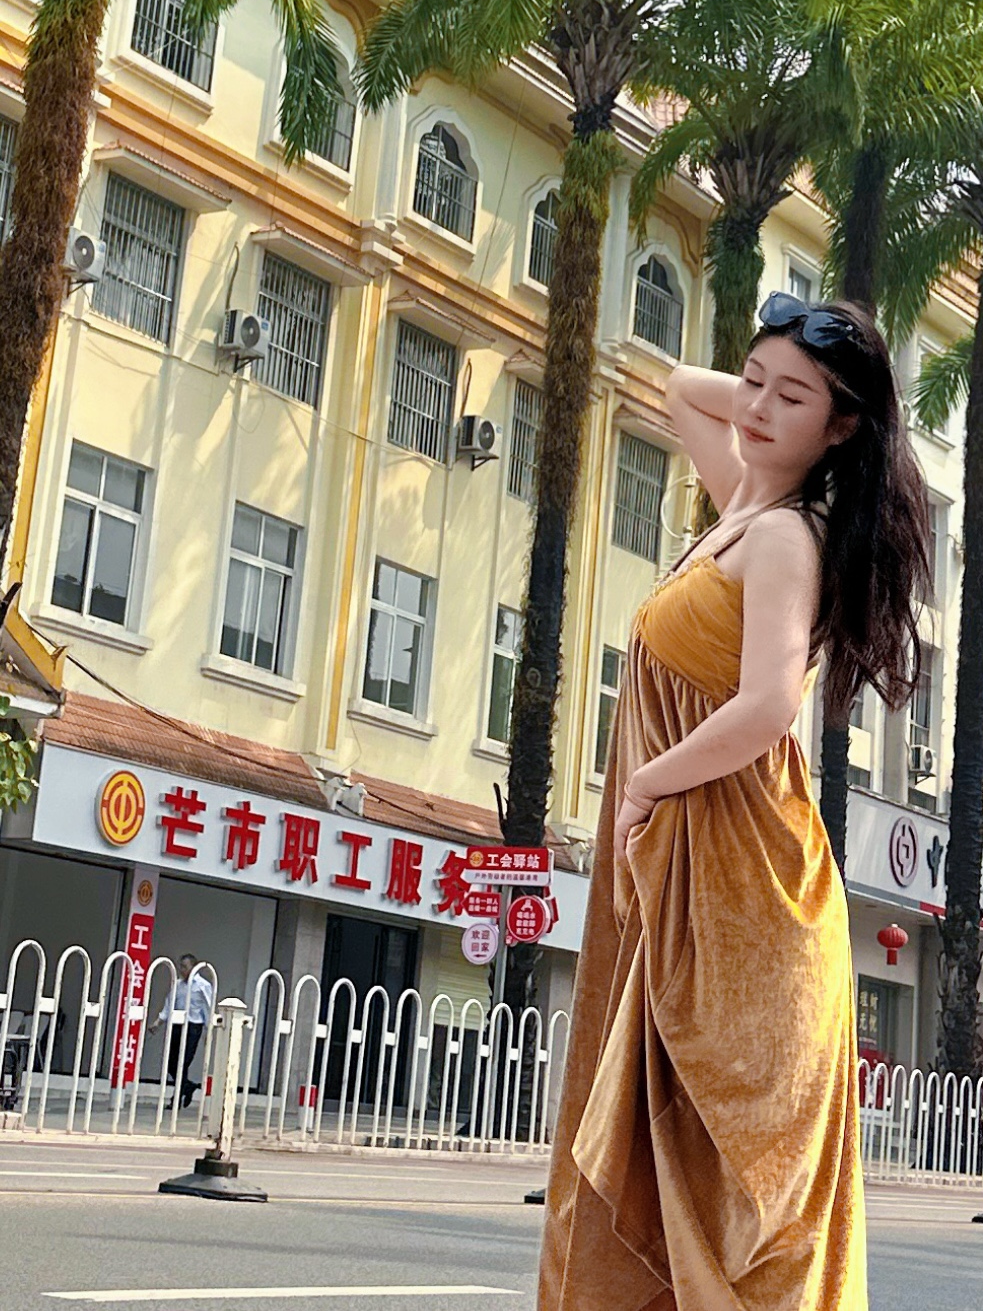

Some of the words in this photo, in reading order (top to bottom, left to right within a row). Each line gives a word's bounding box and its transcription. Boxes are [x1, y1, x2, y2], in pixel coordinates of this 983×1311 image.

[157, 785, 560, 934] 芒市职工服务
[486, 853, 541, 869] 工会驿站
[471, 929, 491, 940] 欢迎
[470, 941, 490, 952] 回家
